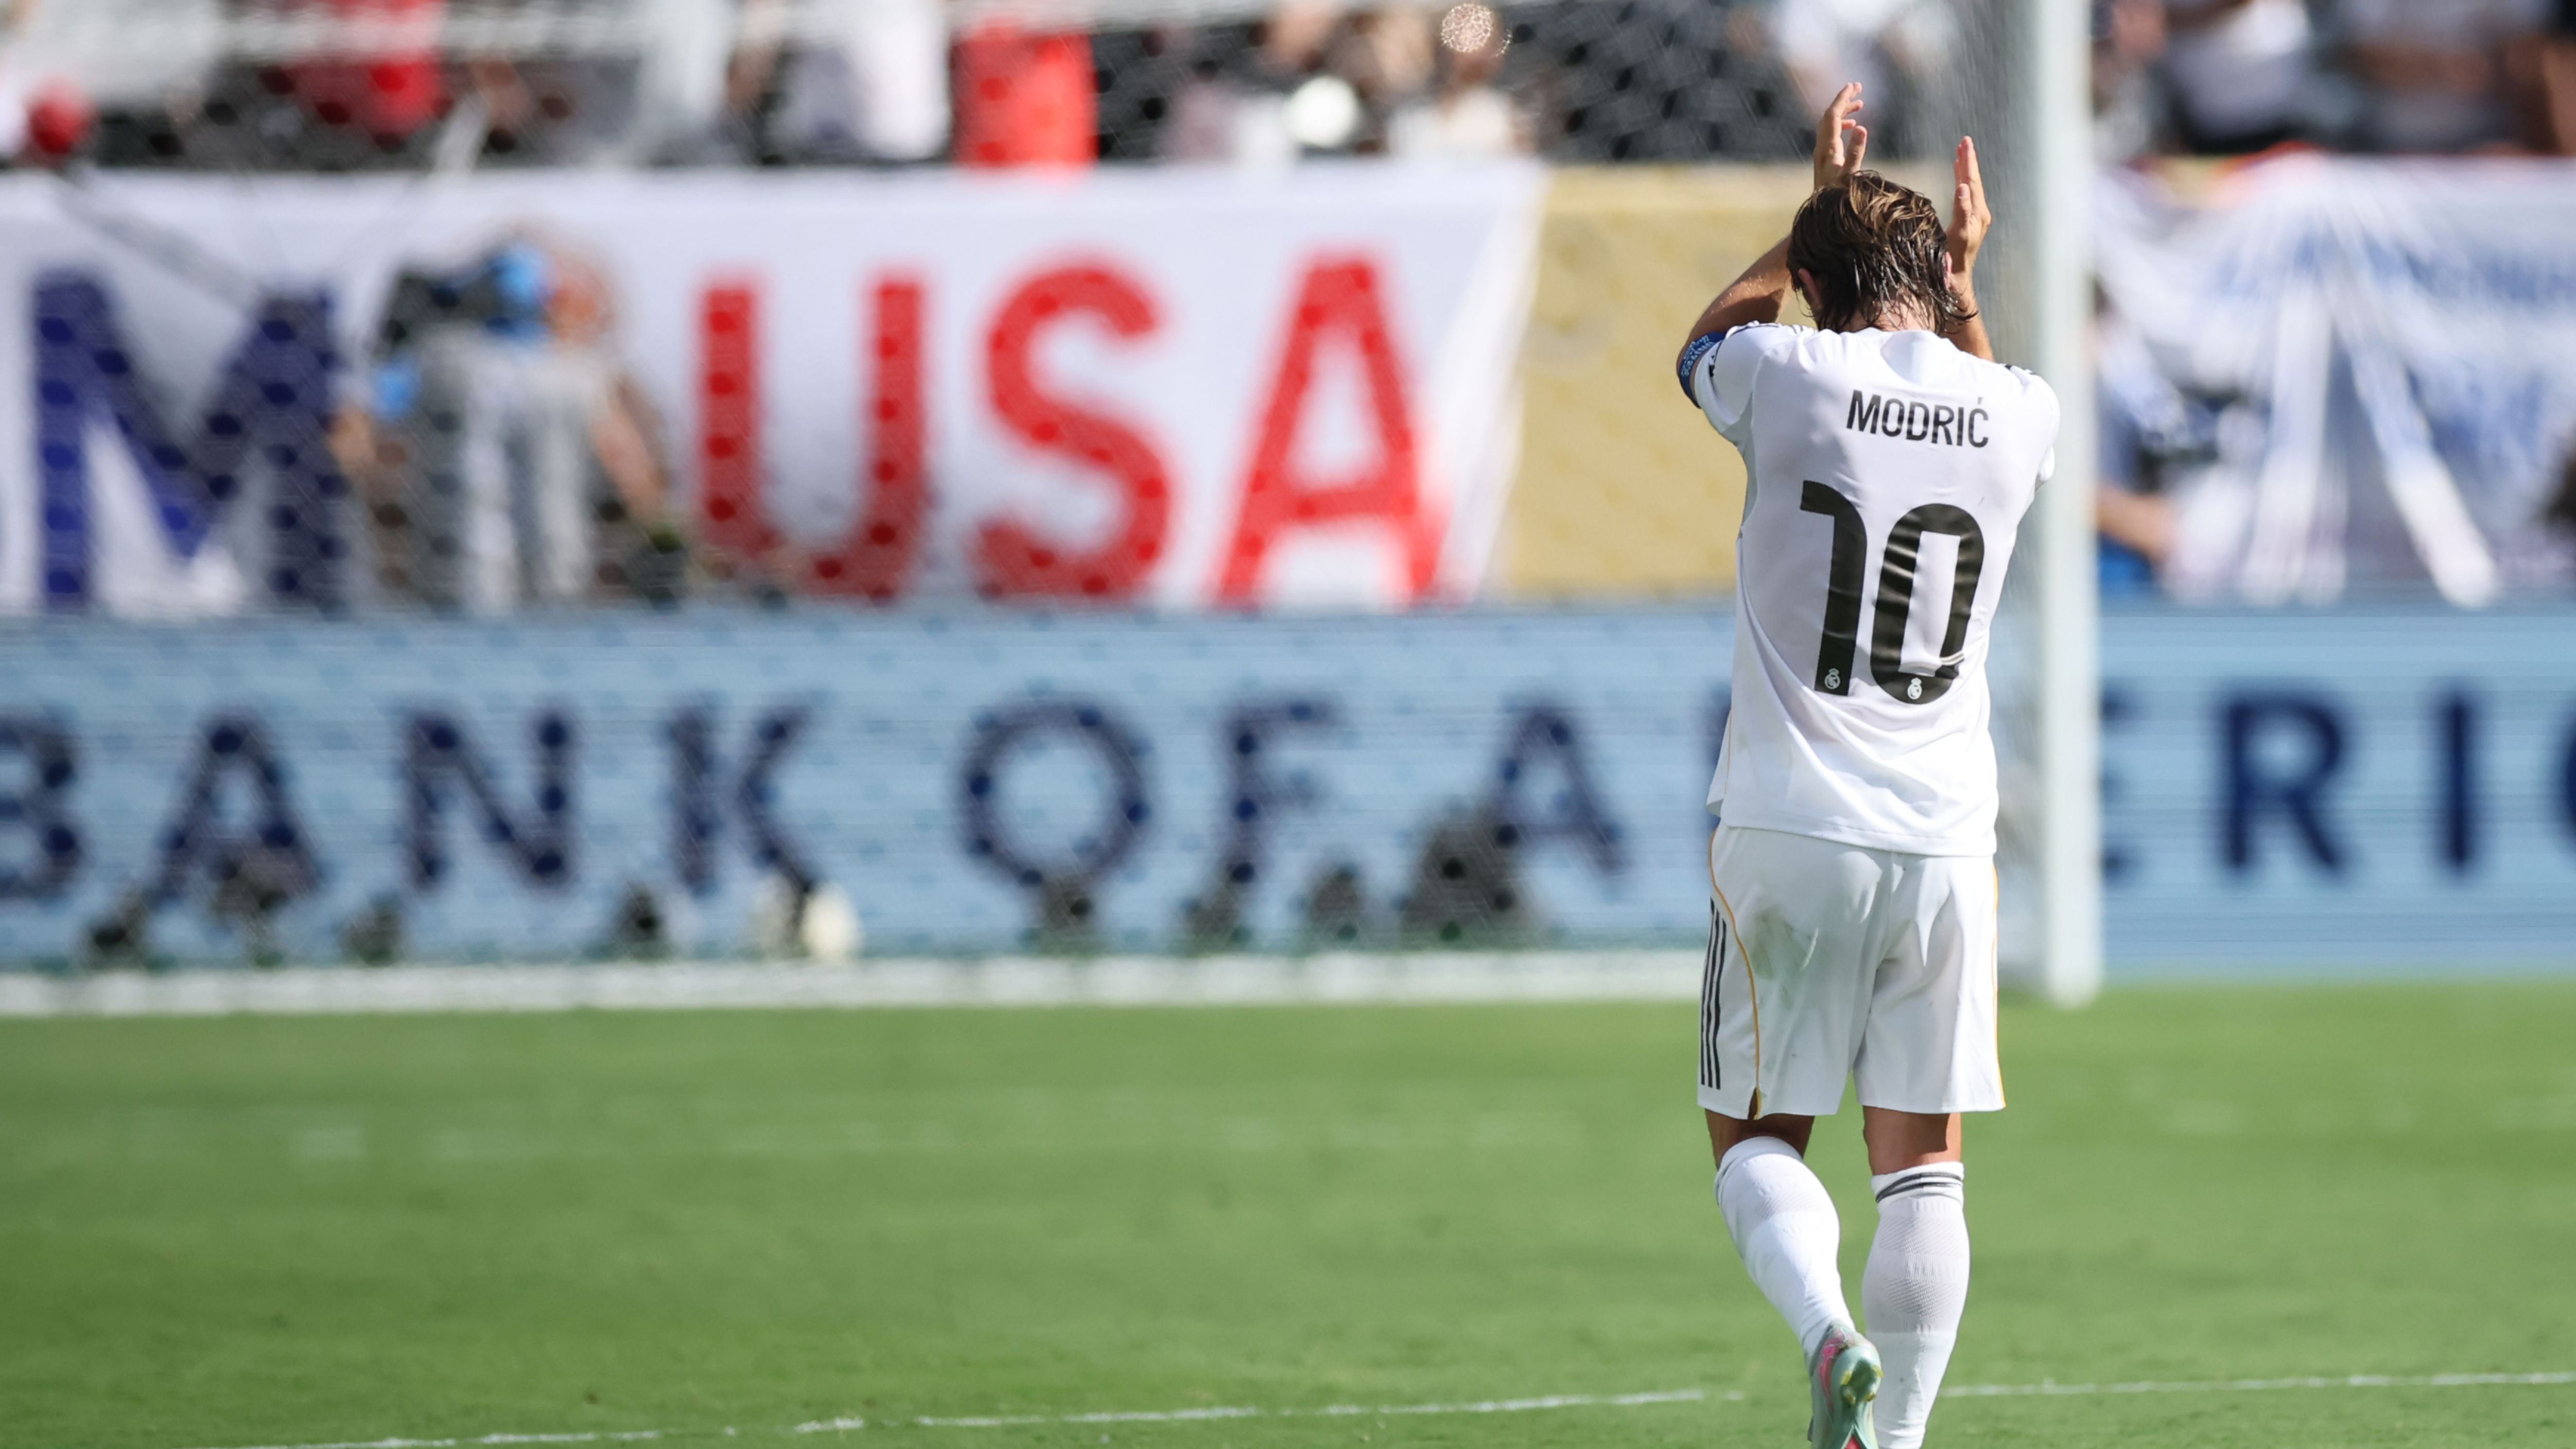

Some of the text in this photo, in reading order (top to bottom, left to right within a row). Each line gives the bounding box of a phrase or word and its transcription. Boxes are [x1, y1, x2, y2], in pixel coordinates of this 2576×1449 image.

[0, 250, 1447, 613] M USA
[1848, 390, 1989, 448] MODRIĆ
[1800, 480, 1985, 704] 10
[0, 701, 824, 897] BANK
[953, 694, 1338, 903] OF
